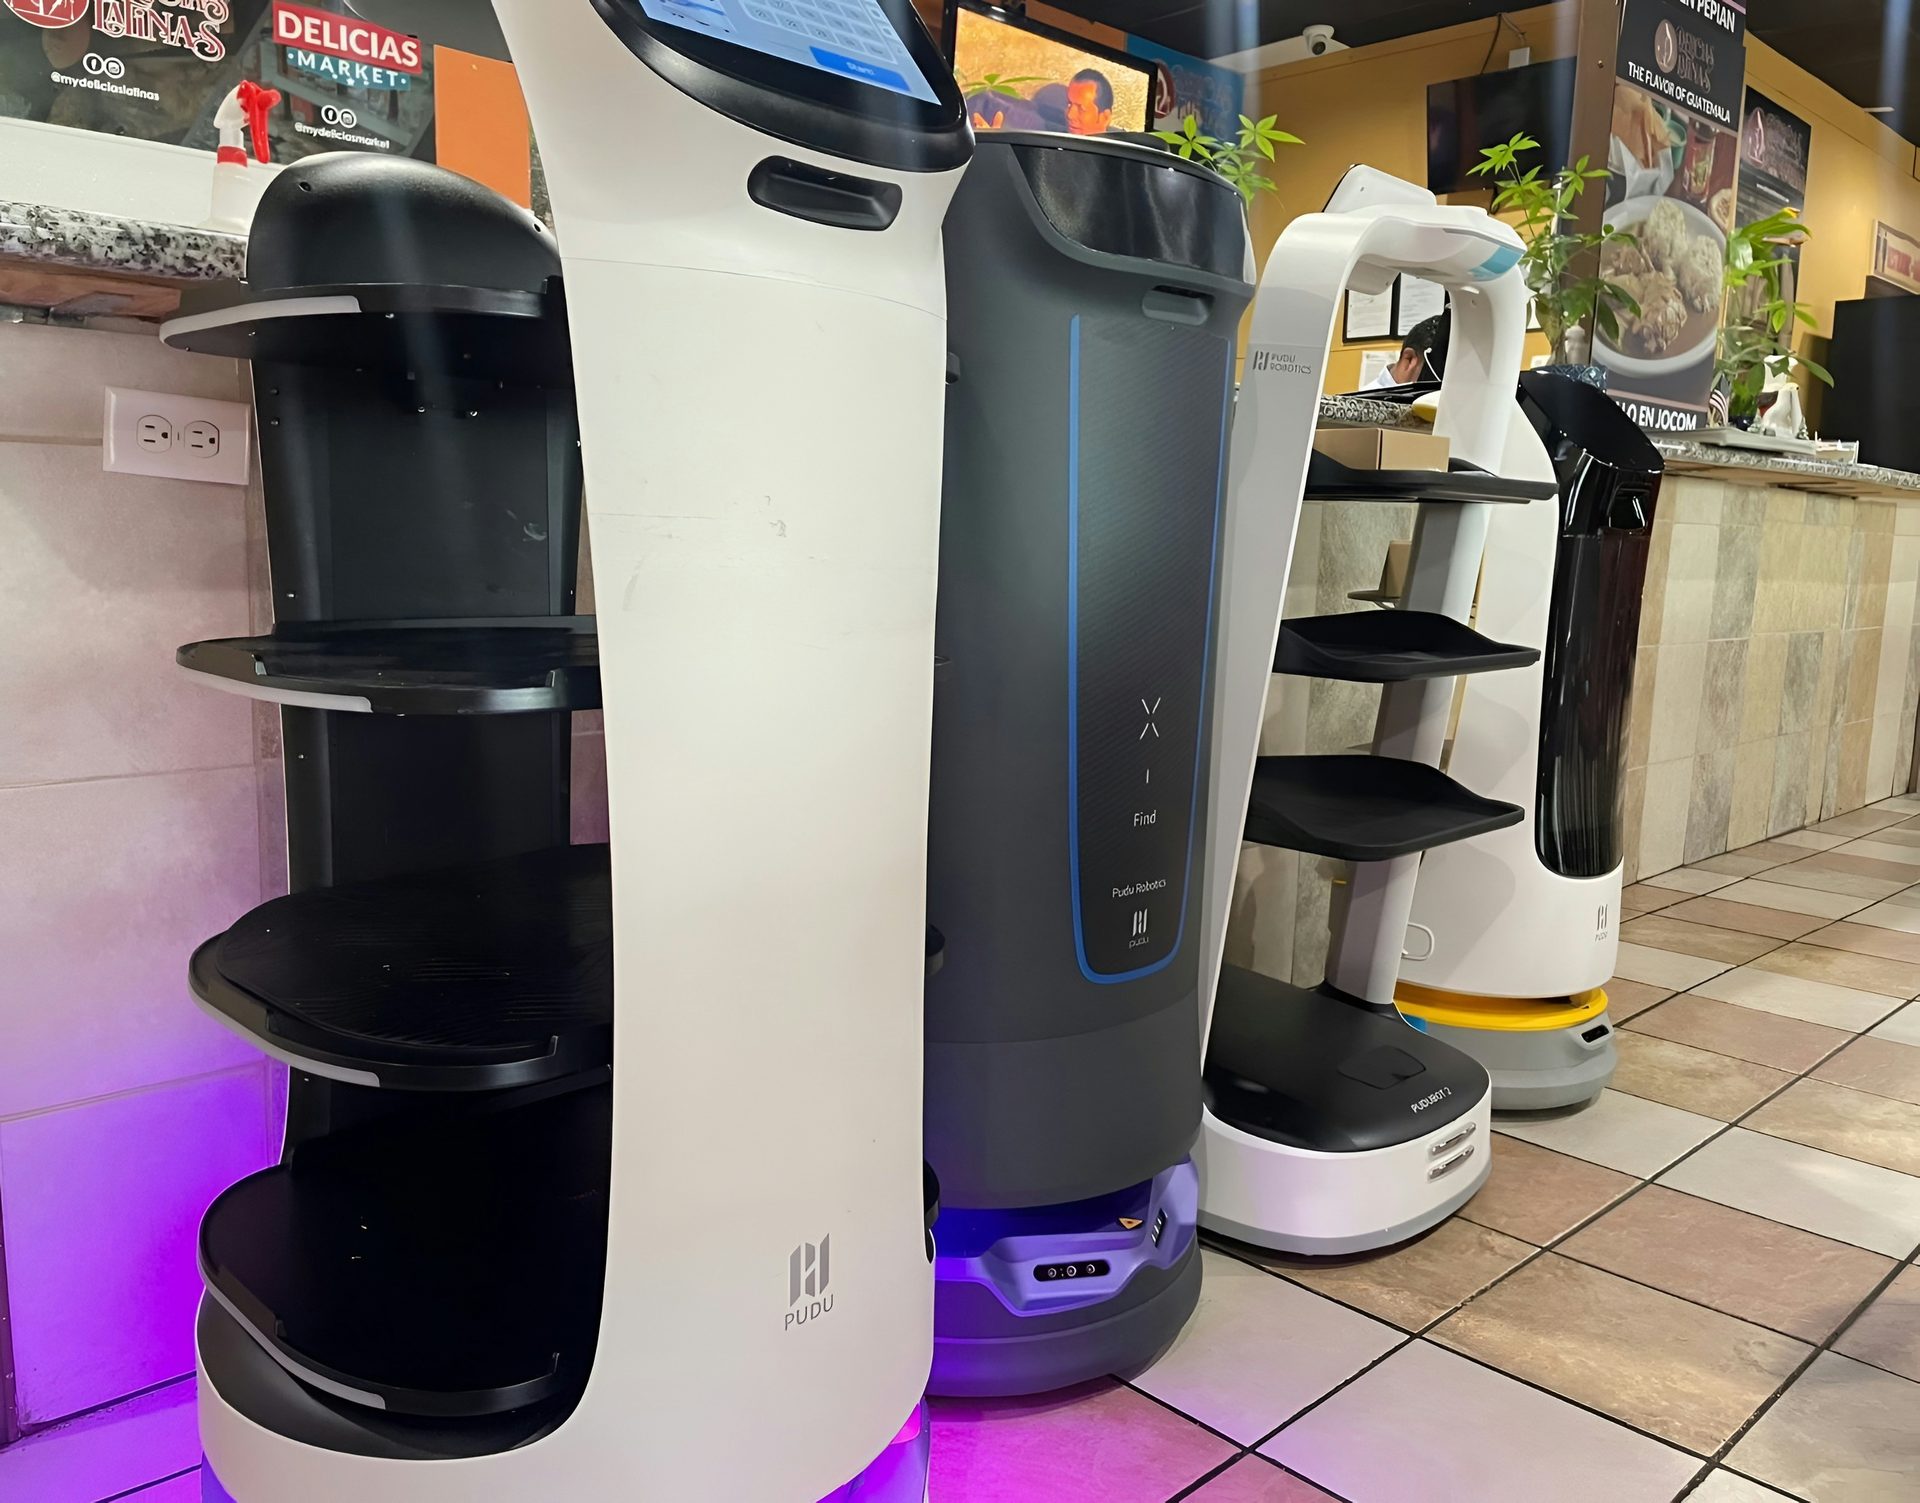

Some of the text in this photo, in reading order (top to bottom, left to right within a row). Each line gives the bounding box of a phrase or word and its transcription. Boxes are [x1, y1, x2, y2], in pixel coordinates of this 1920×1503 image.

[278, 9, 418, 67] DELICIAS
[297, 51, 398, 86] MARKET
[50, 71, 160, 101] @mydeliciaslatinas
[1628, 61, 1731, 123] THE FLAVOR OF GUATEMALA
[294, 122, 390, 149] @mydeliciasmarket
[1639, 405, 1655, 428] EN
[1655, 408, 1697, 431] JOCOM
[1133, 810, 1157, 827] Find
[1112, 885, 1134, 898] Pudu
[1411, 1089, 1446, 1114] PUDUBOT
[784, 1293, 834, 1332] PUDU
